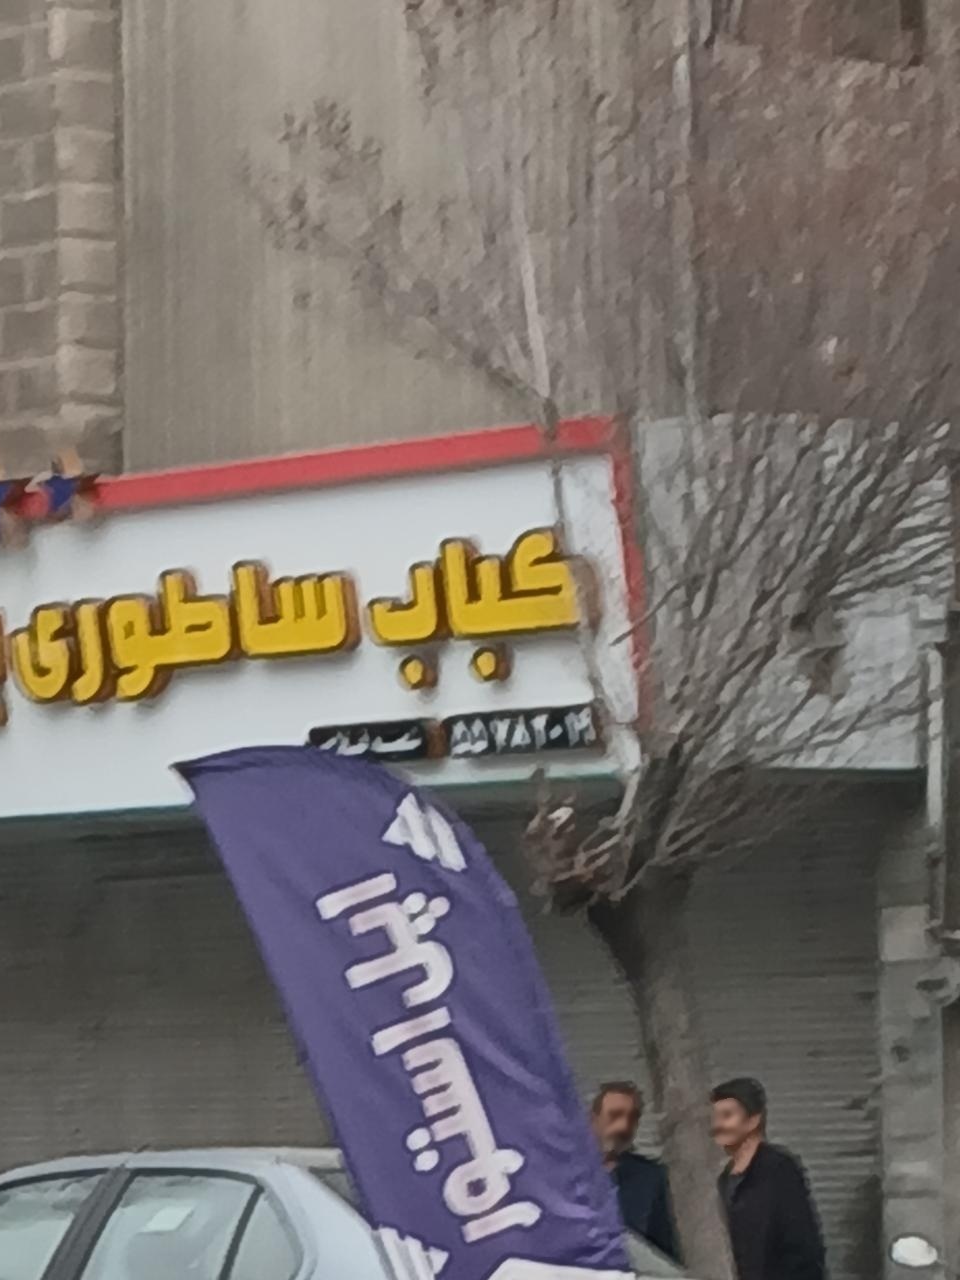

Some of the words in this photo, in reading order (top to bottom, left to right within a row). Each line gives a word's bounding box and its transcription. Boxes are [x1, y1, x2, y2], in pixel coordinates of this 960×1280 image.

[13, 560, 351, 702] ساطوری
[369, 527, 584, 690] کباب
[316, 872, 454, 1008] اپل
[371, 1007, 542, 1244] استور
